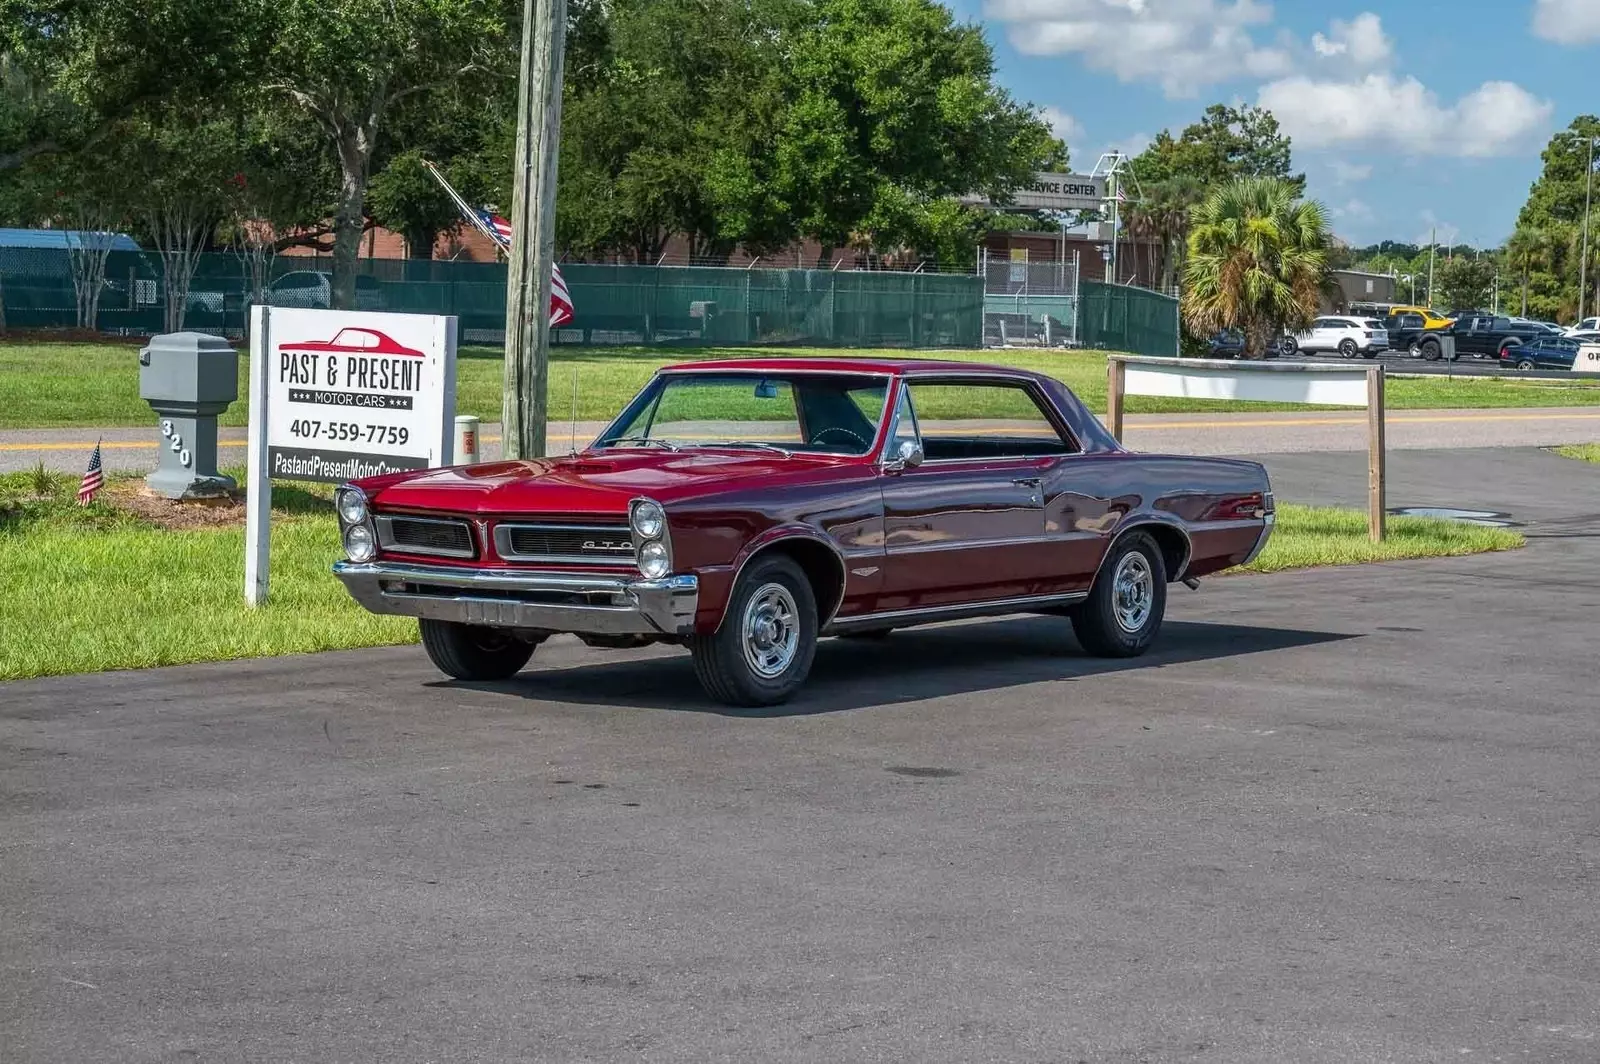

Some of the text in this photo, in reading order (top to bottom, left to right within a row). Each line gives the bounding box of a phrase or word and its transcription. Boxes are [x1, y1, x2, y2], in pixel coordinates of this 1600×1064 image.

[1063, 183, 1096, 196] CENTER
[280, 353, 423, 392] PAST & PRESENT
[314, 392, 386, 408] MOTOR CARS
[162, 420, 190, 466] 320
[290, 419, 409, 446] 407-559-7759
[274, 452, 415, 480] PastandPresentMotorCa
[583, 541, 633, 549] GTO
